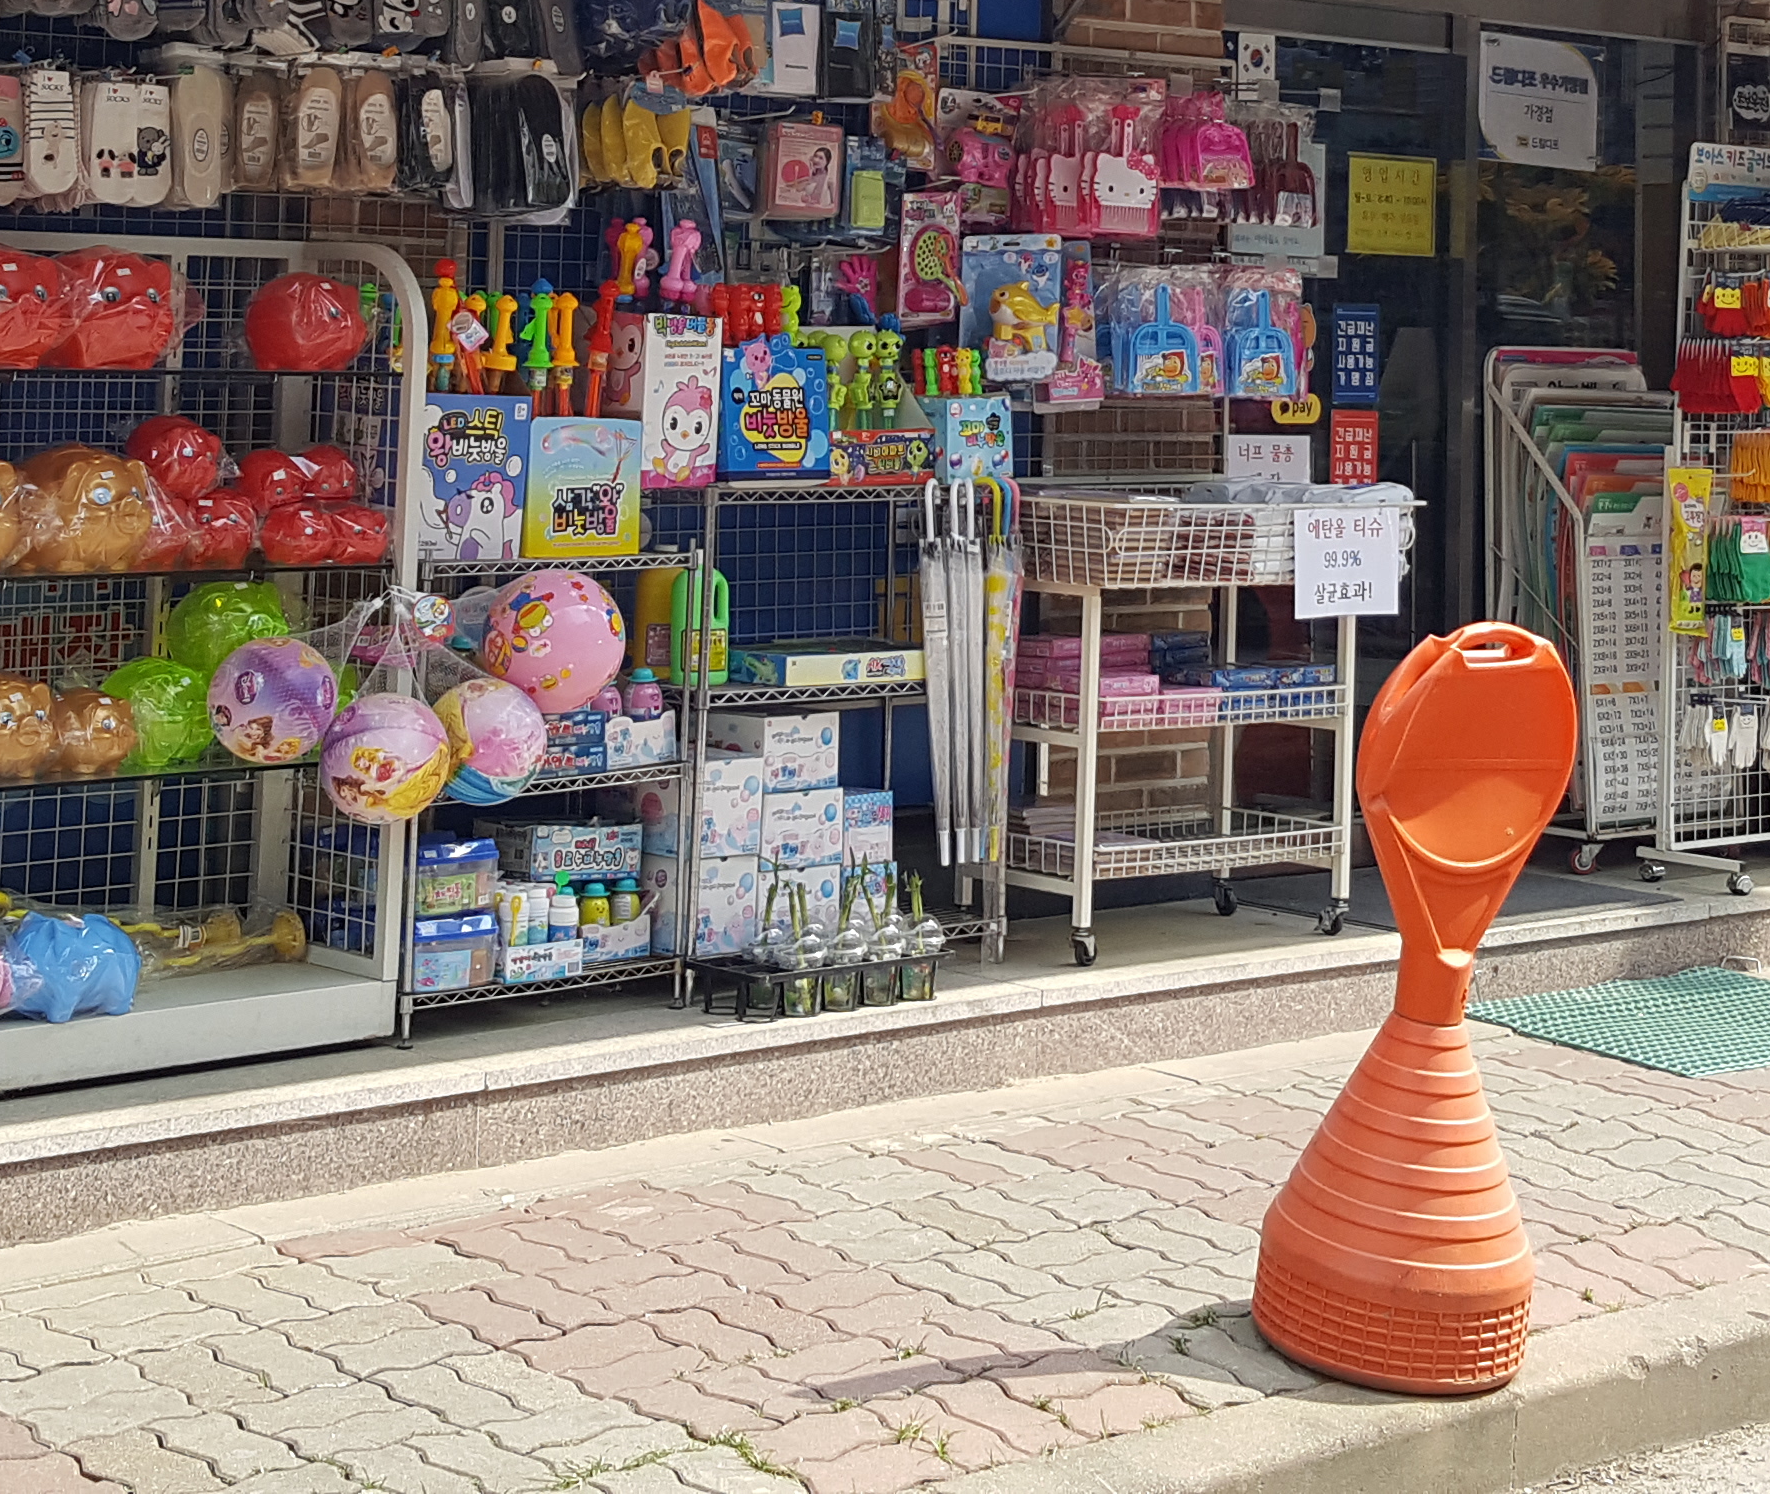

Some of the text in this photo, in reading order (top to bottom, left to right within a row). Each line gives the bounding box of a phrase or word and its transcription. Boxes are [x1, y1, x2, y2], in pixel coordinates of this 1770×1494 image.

[1524, 104, 1554, 124] 가경점
[1726, 150, 1747, 168] 키즈
[1292, 399, 1313, 416] pay
[442, 409, 504, 437] LED 스틱
[1238, 442, 1295, 463] 너프 물총
[1307, 517, 1384, 540] 에탄올 티슈
[1324, 550, 1362, 568] 99.9%
[1314, 581, 1373, 605] 살균효과!
